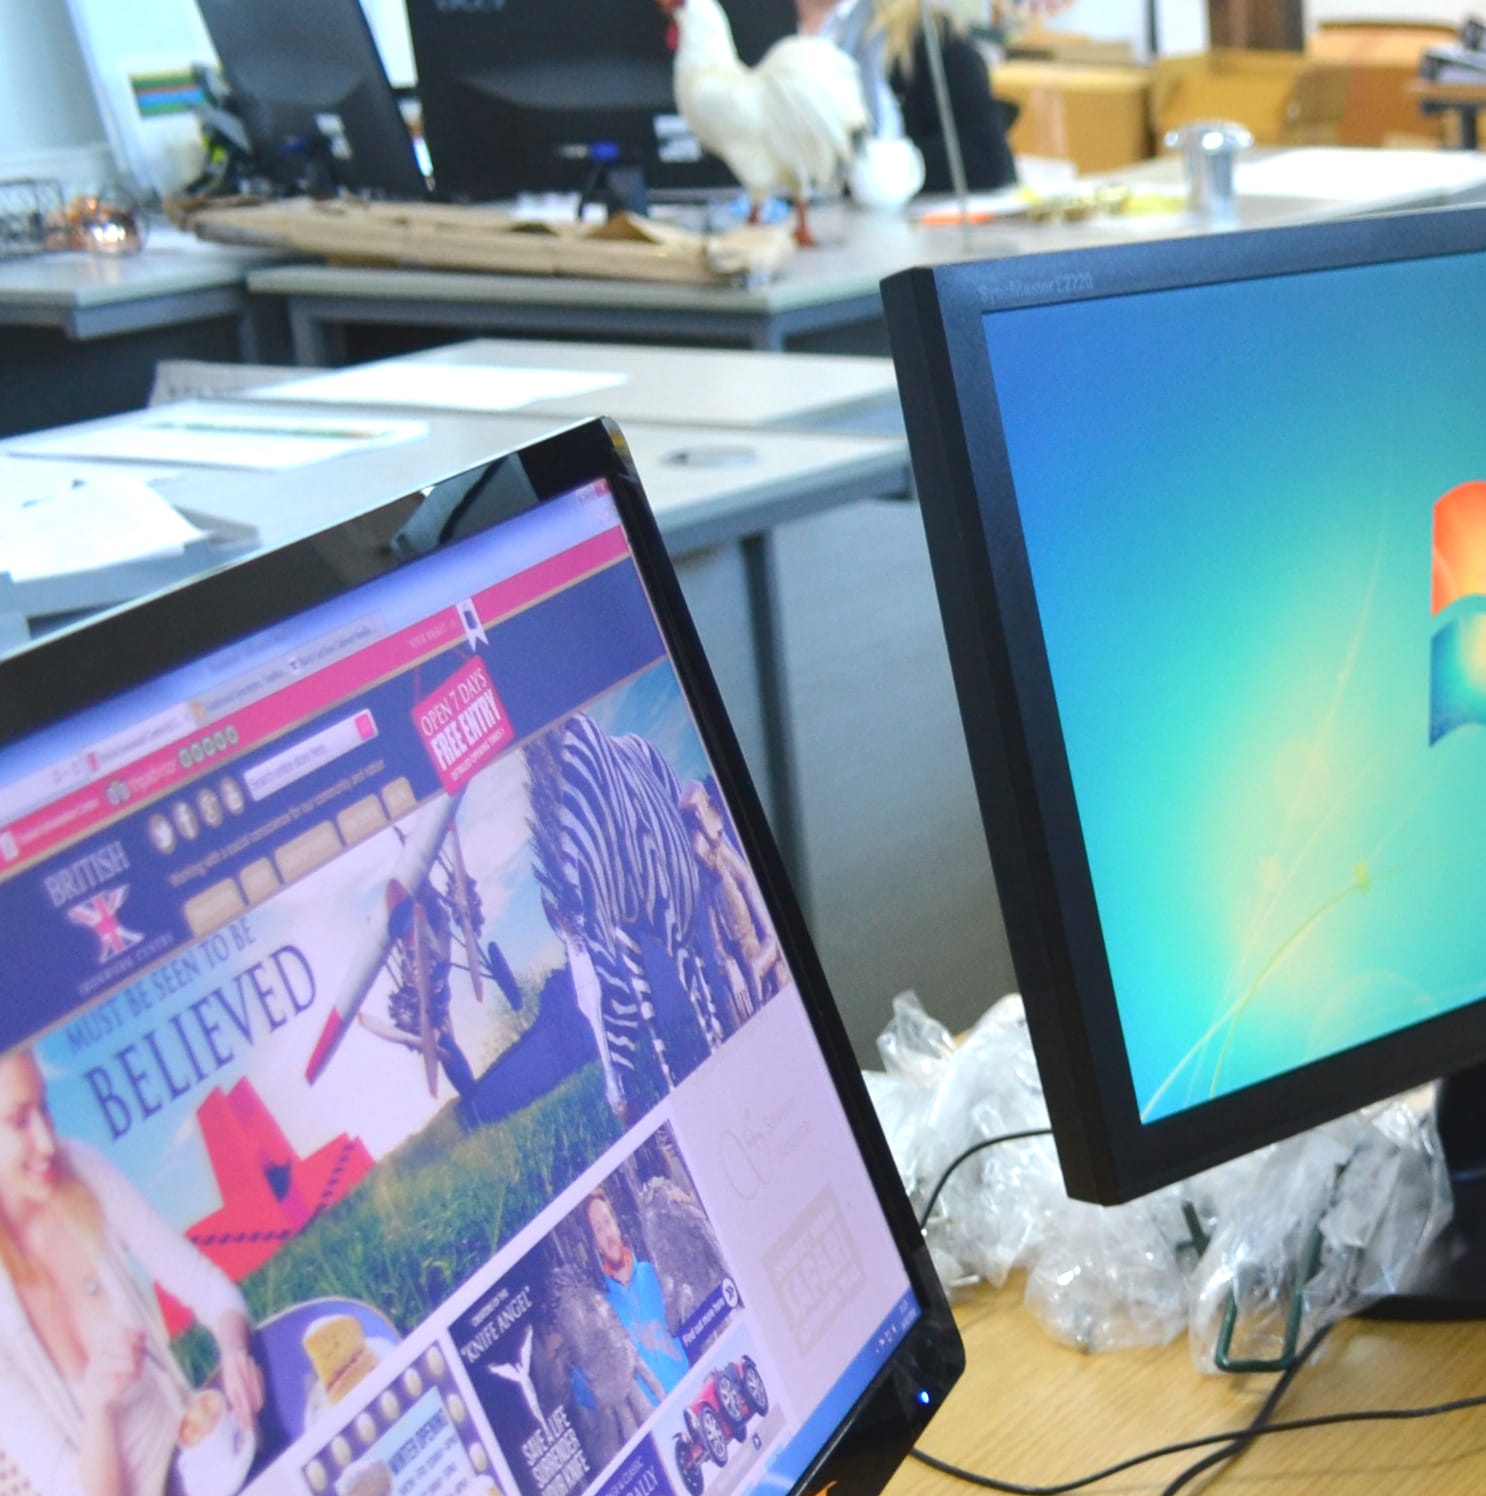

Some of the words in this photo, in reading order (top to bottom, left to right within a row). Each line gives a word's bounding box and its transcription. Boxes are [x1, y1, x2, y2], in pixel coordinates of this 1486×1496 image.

[420, 698, 453, 737] OPEN
[449, 690, 461, 711] 7
[458, 667, 488, 702] DAYS
[430, 720, 467, 772] FREE
[458, 689, 502, 747] ENTRY
[44, 840, 130, 908] BRITISH
[64, 992, 125, 1054] MUST
[150, 957, 200, 1002] SEEN
[202, 933, 231, 970] TO
[82, 944, 317, 1142] BELIEVED
